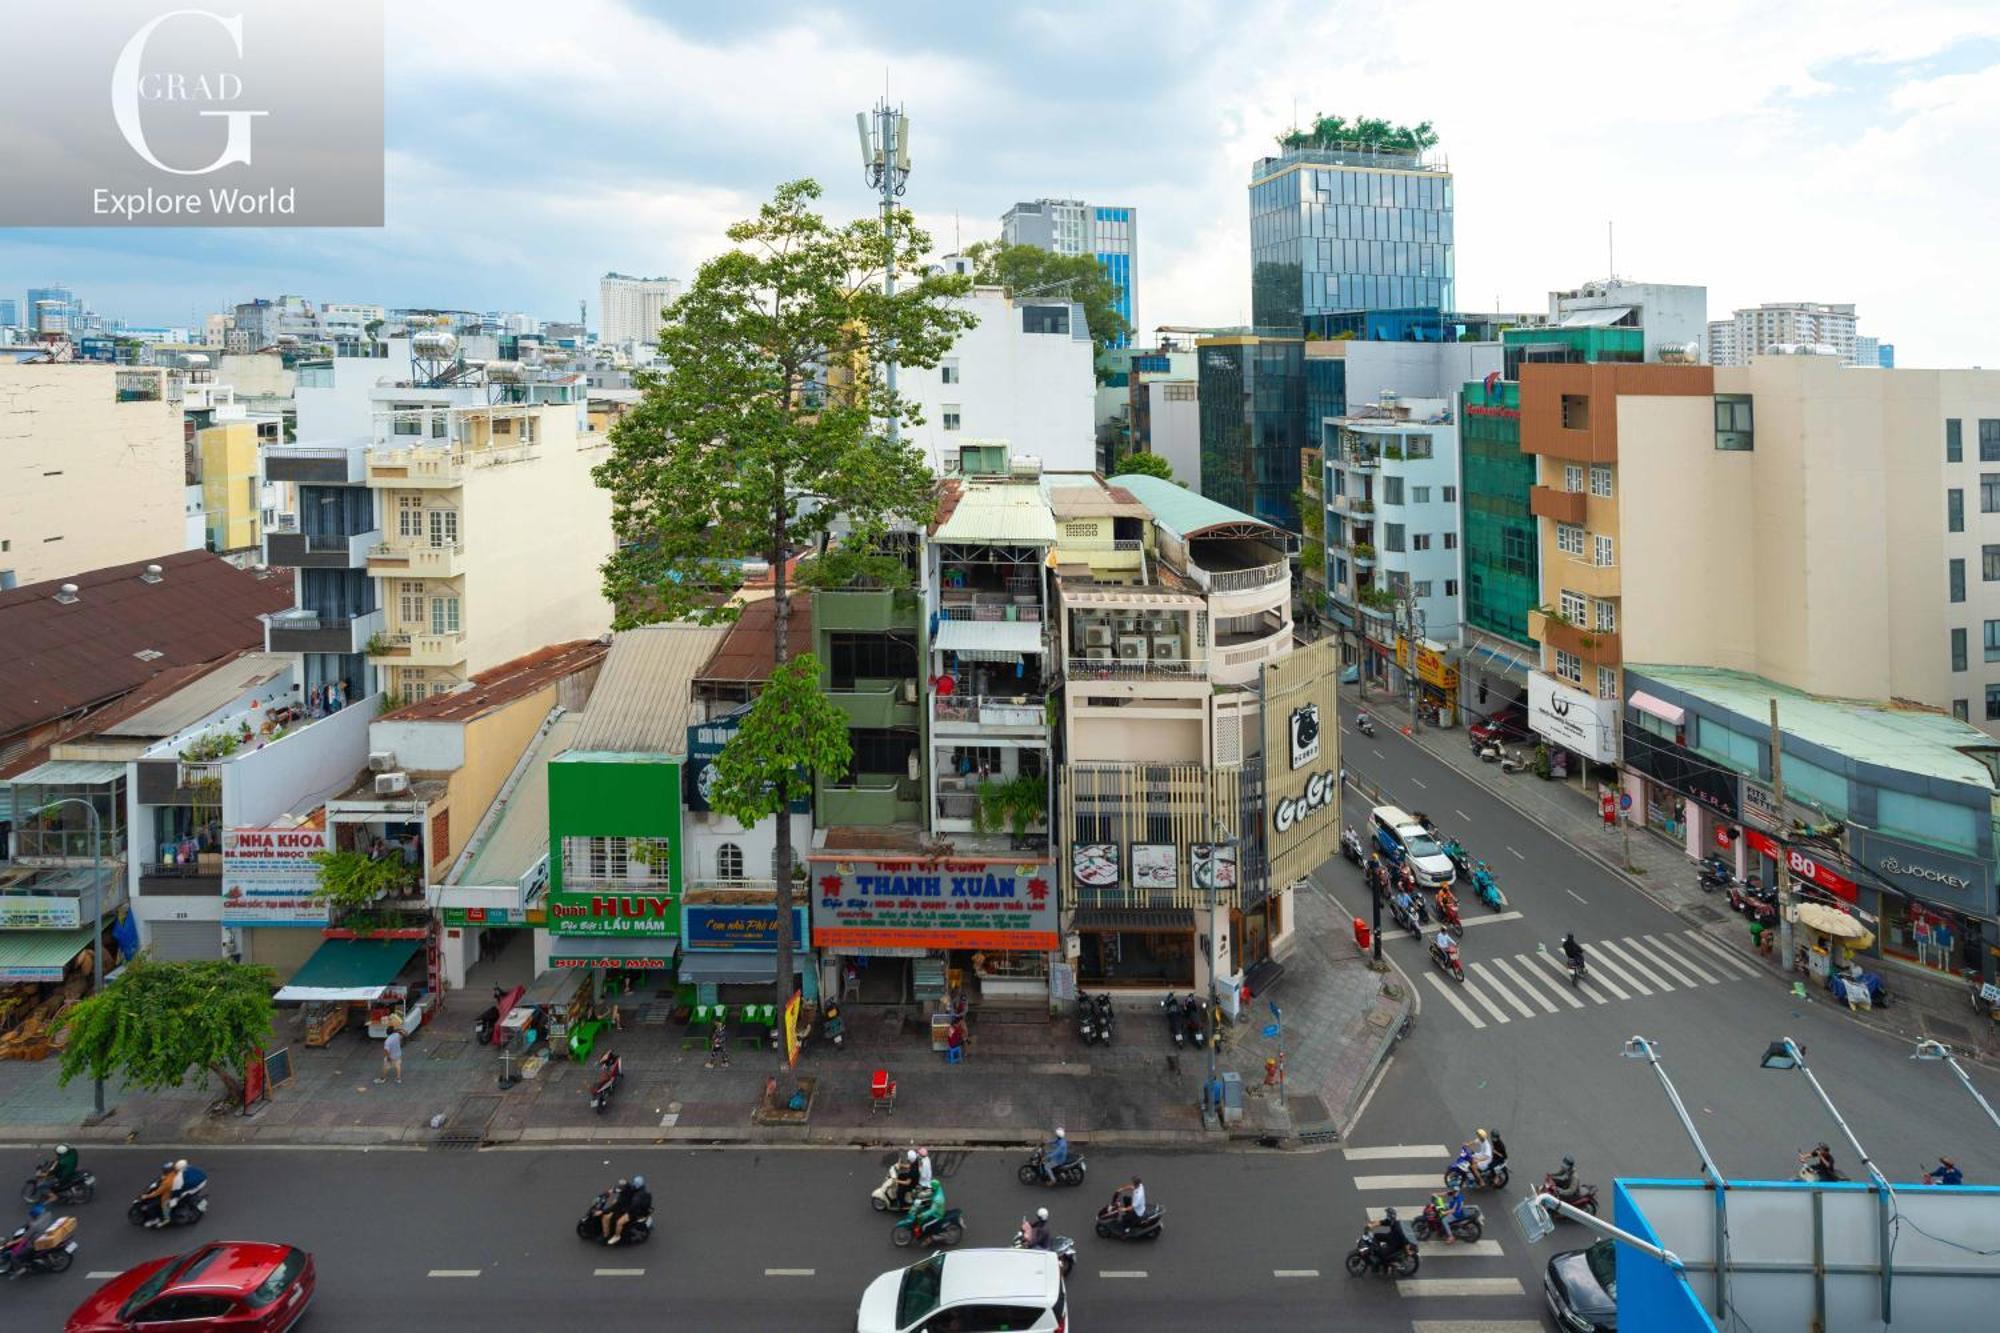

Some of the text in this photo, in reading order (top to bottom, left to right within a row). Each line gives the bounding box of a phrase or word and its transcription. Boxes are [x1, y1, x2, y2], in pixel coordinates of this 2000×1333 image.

[1275, 771, 1333, 833] GoGi
[1689, 785, 1730, 813] VERA
[239, 834, 325, 848] NHA KHOA
[1792, 852, 1815, 878] 80
[1902, 865, 1970, 889] JOCKEY
[856, 873, 1015, 897] THANH XUÂN
[552, 896, 673, 918] Quán HUY
[921, 902, 947, 910] QUAY
[974, 902, 1001, 910] QUAY
[1003, 901, 1024, 911] THÁI
[1027, 902, 1046, 911] LAN
